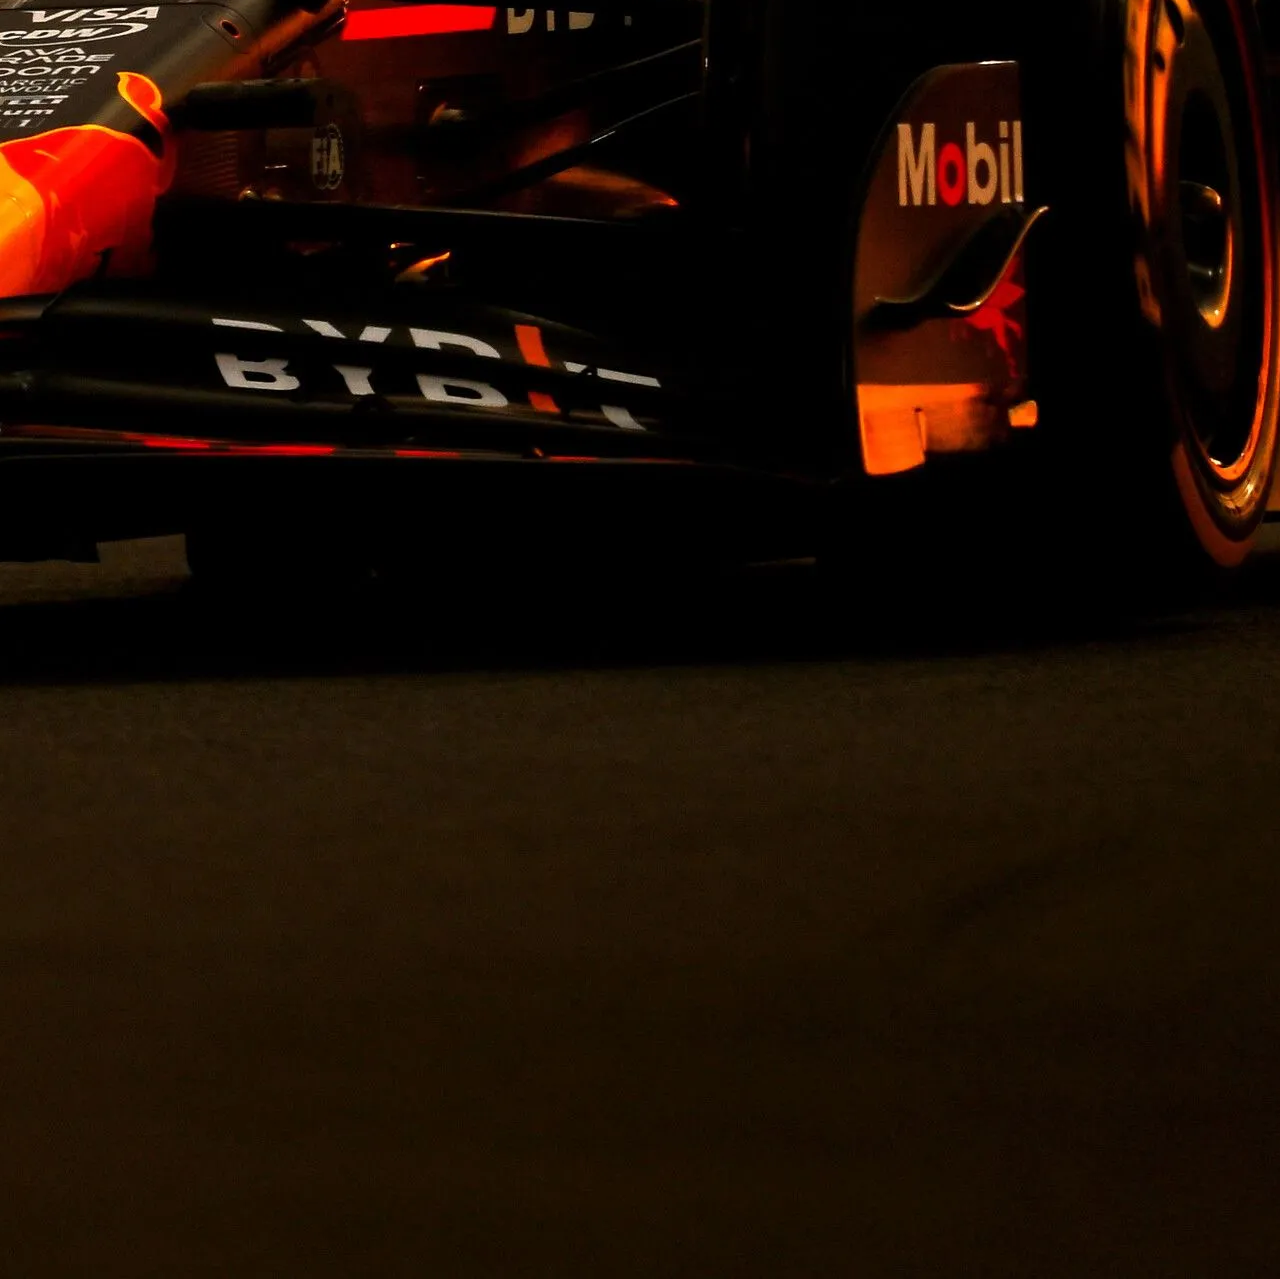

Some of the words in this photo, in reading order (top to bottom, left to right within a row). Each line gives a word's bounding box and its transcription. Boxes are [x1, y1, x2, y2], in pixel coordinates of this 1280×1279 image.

[23, 5, 161, 24] VISA
[2, 46, 86, 58] AVA
[896, 120, 1025, 207] Mobil
